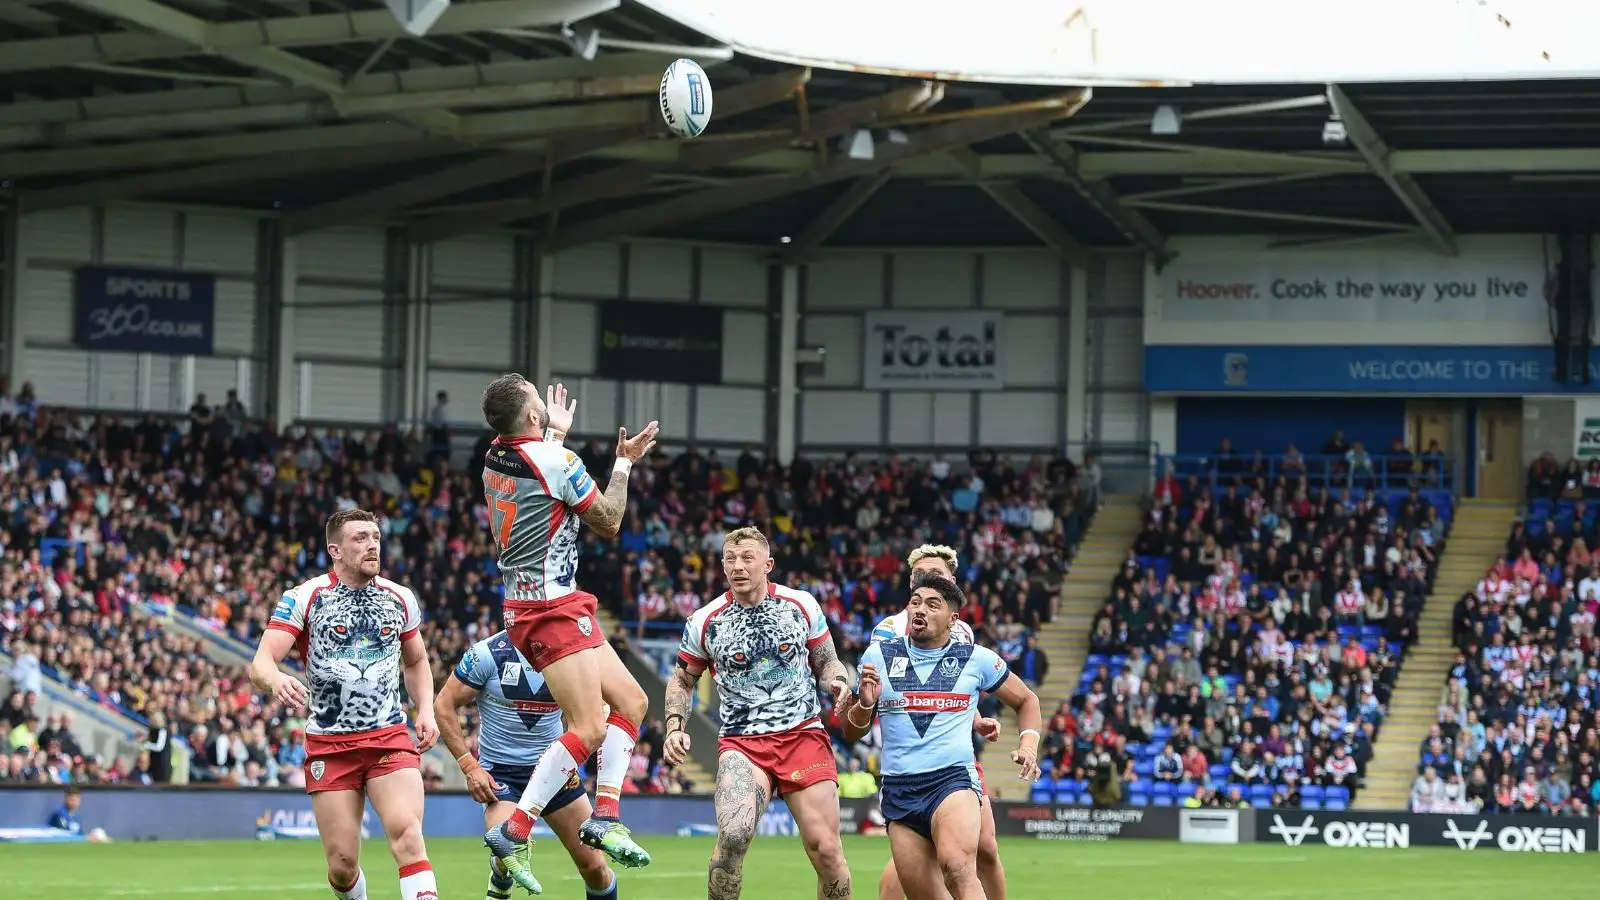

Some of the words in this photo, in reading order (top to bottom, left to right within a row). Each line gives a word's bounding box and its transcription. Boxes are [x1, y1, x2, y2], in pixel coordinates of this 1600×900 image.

[106, 276, 191, 300] SPORTS
[1176, 279, 1260, 299] Hoover.
[1270, 277, 1328, 299] Cook
[1336, 277, 1374, 299] the
[1380, 281, 1425, 302] way
[1433, 281, 1477, 302] you
[1487, 276, 1529, 298] live
[873, 321, 996, 368] Total
[1349, 360, 1454, 380] WELCOME
[1463, 360, 1492, 380] TO
[1499, 360, 1540, 380] THE
[485, 494, 518, 549] 17
[912, 696, 969, 709] bargains
[1025, 820, 1067, 833] ENERGY
[1056, 808, 1091, 821] LARGE
[1323, 821, 1410, 848] OXEN
[1497, 826, 1586, 853] OXEN
